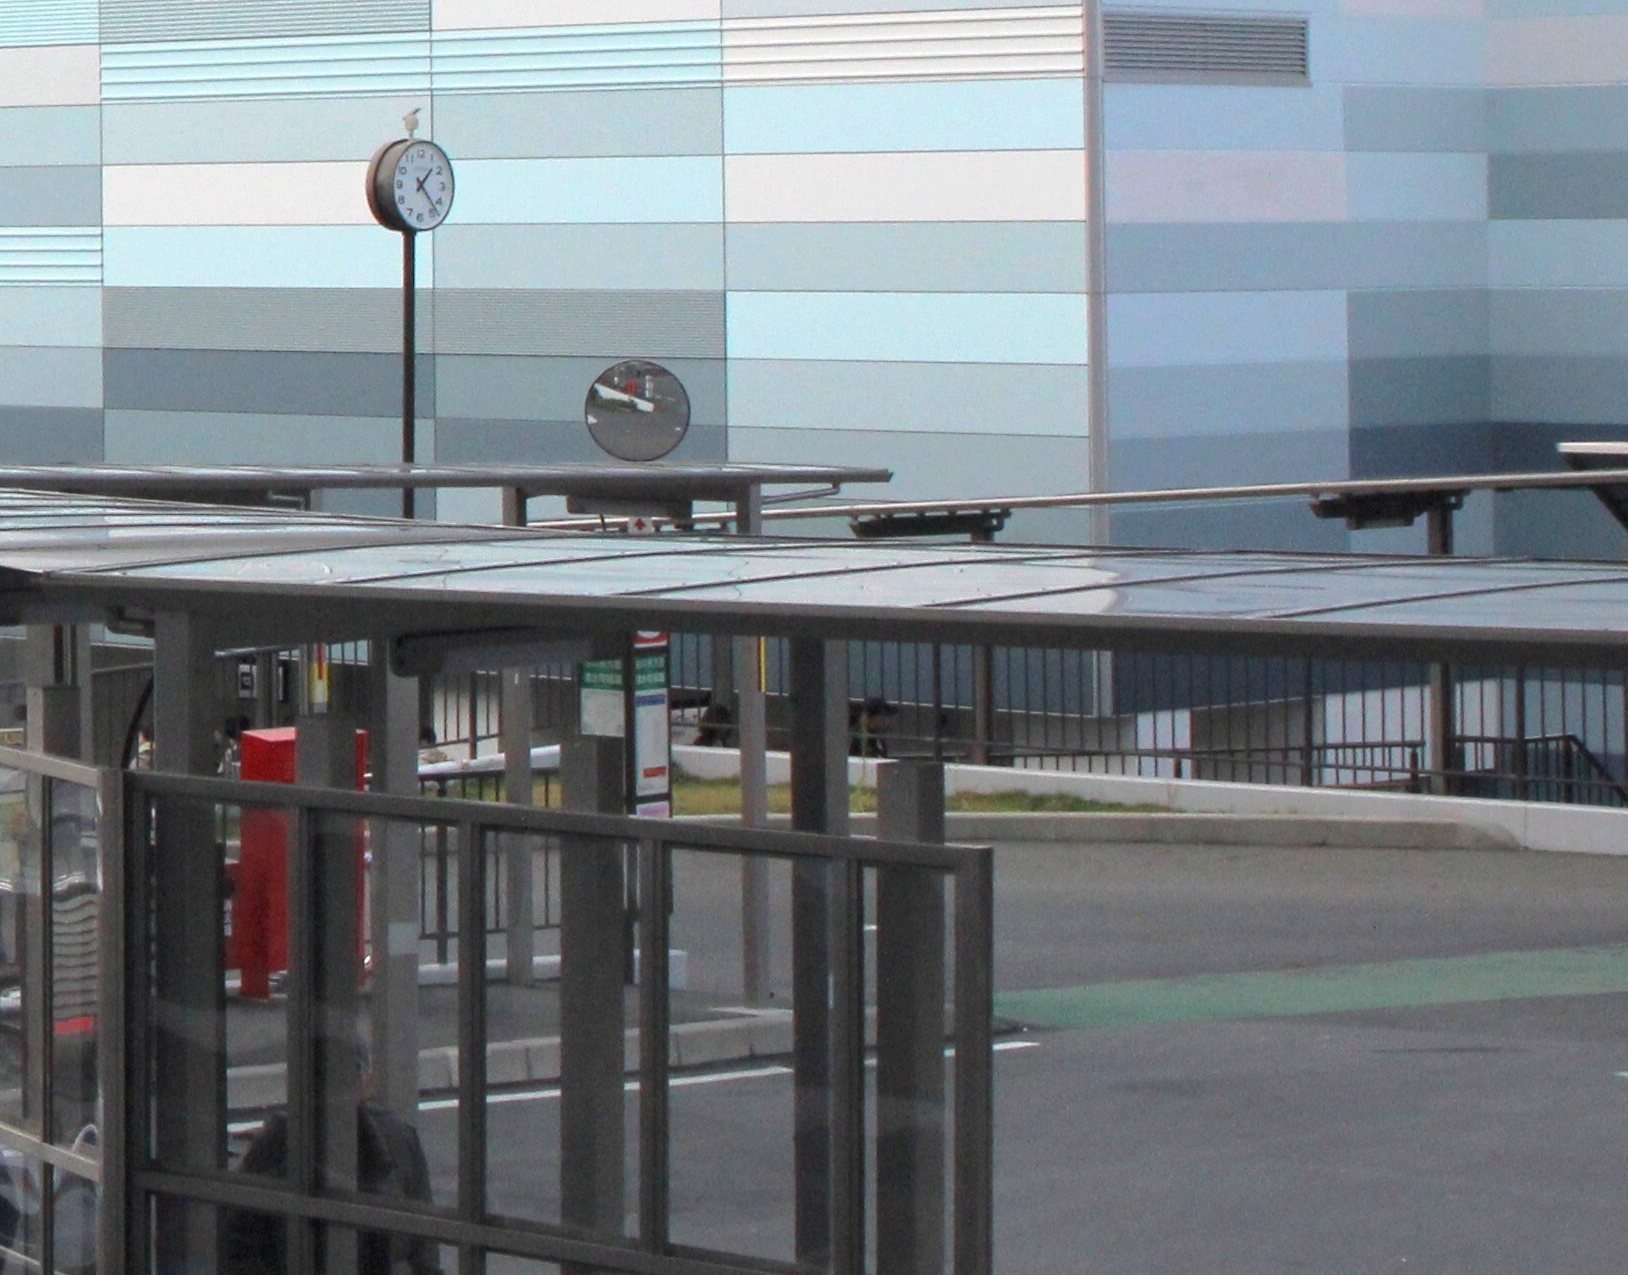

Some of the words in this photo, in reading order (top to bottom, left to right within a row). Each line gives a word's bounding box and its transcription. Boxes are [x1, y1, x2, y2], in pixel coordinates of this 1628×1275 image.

[417, 149, 425, 158] 12
[405, 154, 414, 164] 11
[399, 166, 407, 175] 10
[435, 166, 442, 175] 2
[396, 179, 403, 189] 9
[439, 181, 445, 191] 3
[398, 195, 405, 205] 8
[435, 197, 443, 205] 4
[407, 208, 413, 216] 7
[428, 208, 435, 218] 5
[416, 213, 424, 222] 6
